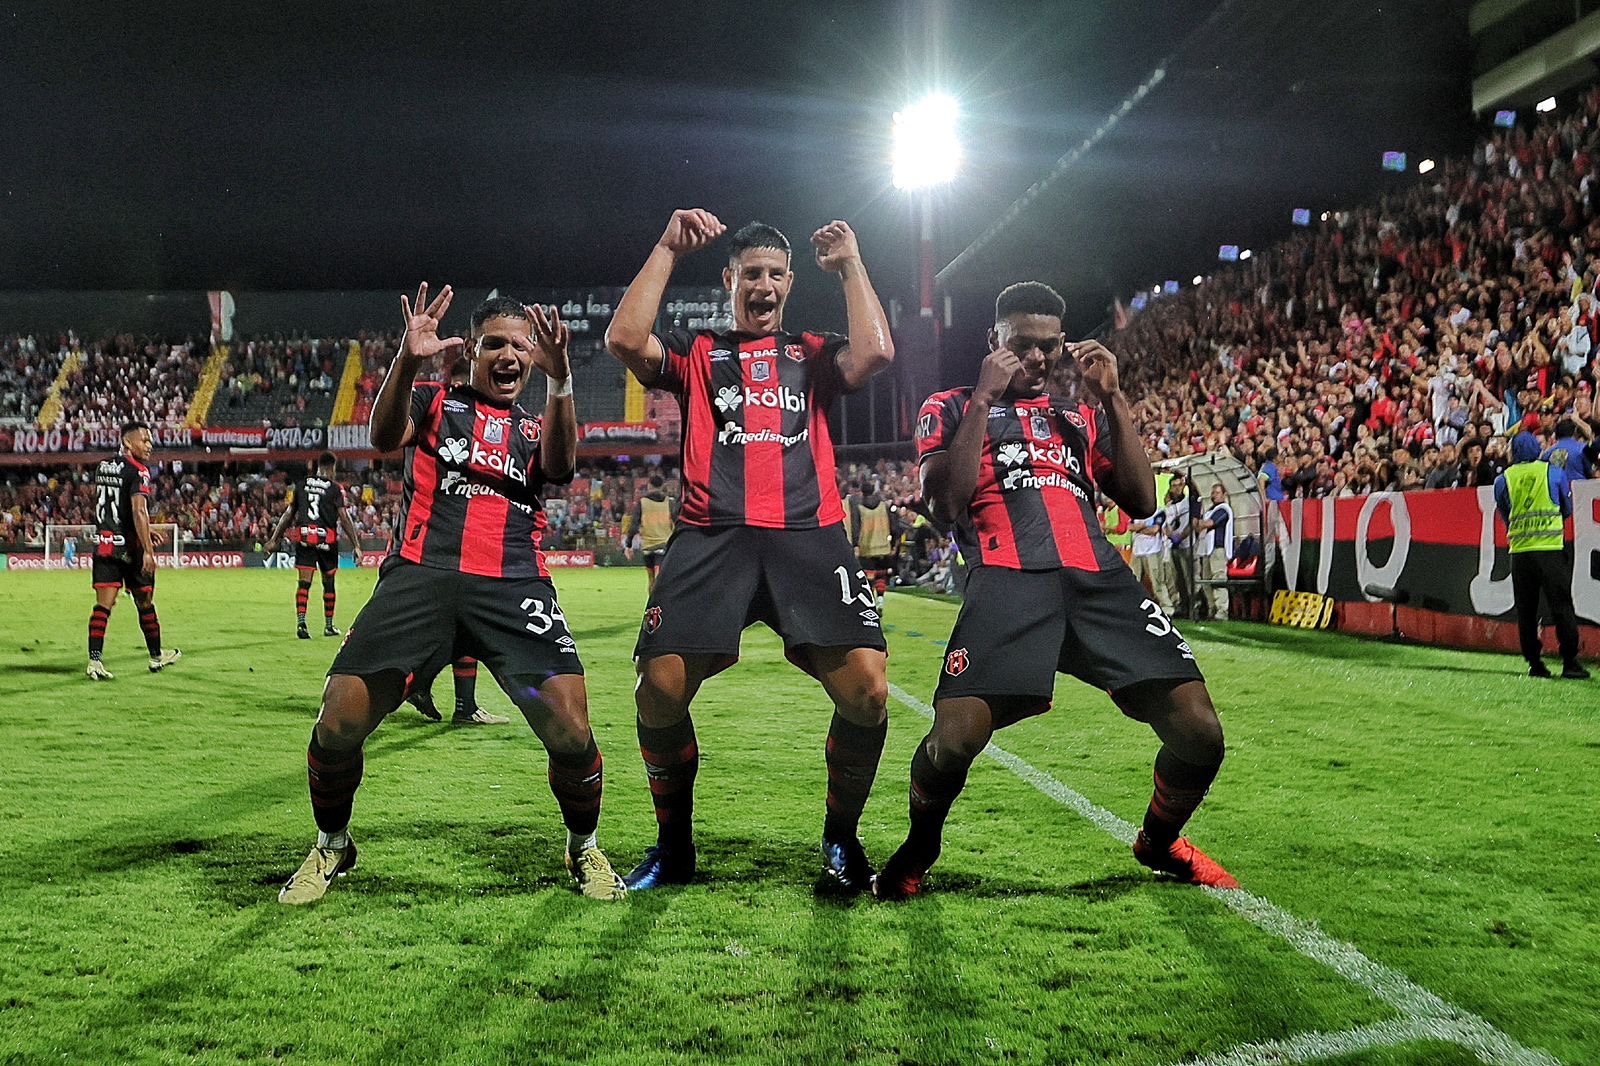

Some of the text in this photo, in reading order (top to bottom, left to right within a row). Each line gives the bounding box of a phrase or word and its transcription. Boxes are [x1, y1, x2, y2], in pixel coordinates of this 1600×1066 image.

[753, 349, 779, 358] BAC
[744, 385, 806, 413] kölbi
[1030, 407, 1057, 417] BAC
[13, 430, 62, 452] ROJO
[731, 428, 809, 447] medismart
[471, 441, 527, 487] kölbi
[1028, 441, 1081, 475] kölb
[307, 493, 321, 521] 3
[211, 554, 242, 567] CUP
[833, 565, 876, 608] 13
[519, 597, 571, 635] 34
[1139, 598, 1184, 640] 3
